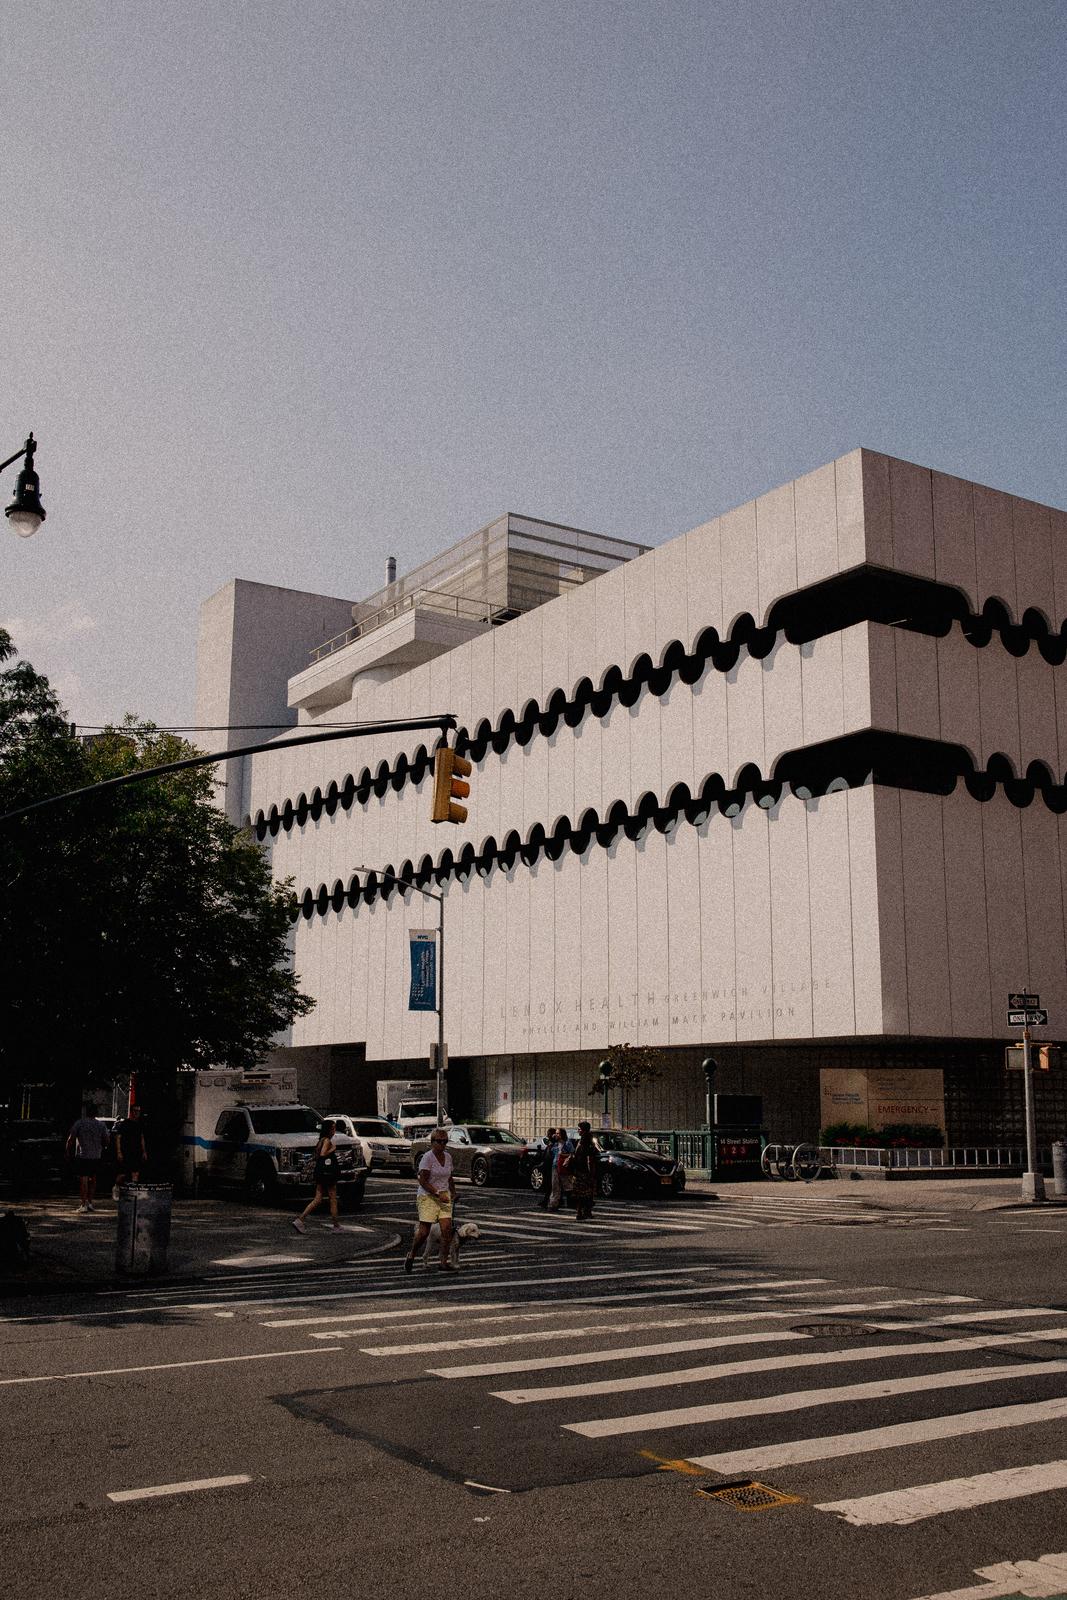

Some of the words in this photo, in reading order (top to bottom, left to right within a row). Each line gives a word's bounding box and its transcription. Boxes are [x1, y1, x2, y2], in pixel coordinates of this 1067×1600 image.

[500, 1000, 562, 1018] LENOX
[575, 992, 655, 1011] HEALTH
[664, 987, 748, 1003] GREENWICH
[762, 980, 831, 994] VILLAGE
[576, 1023, 597, 1032] AND
[609, 1018, 659, 1029] WILLIAM
[672, 1013, 707, 1024] MACK
[721, 1007, 795, 1021] PAVILION
[1028, 1014, 1042, 1022] WAY
[877, 1105, 929, 1114] EMERGENCY
